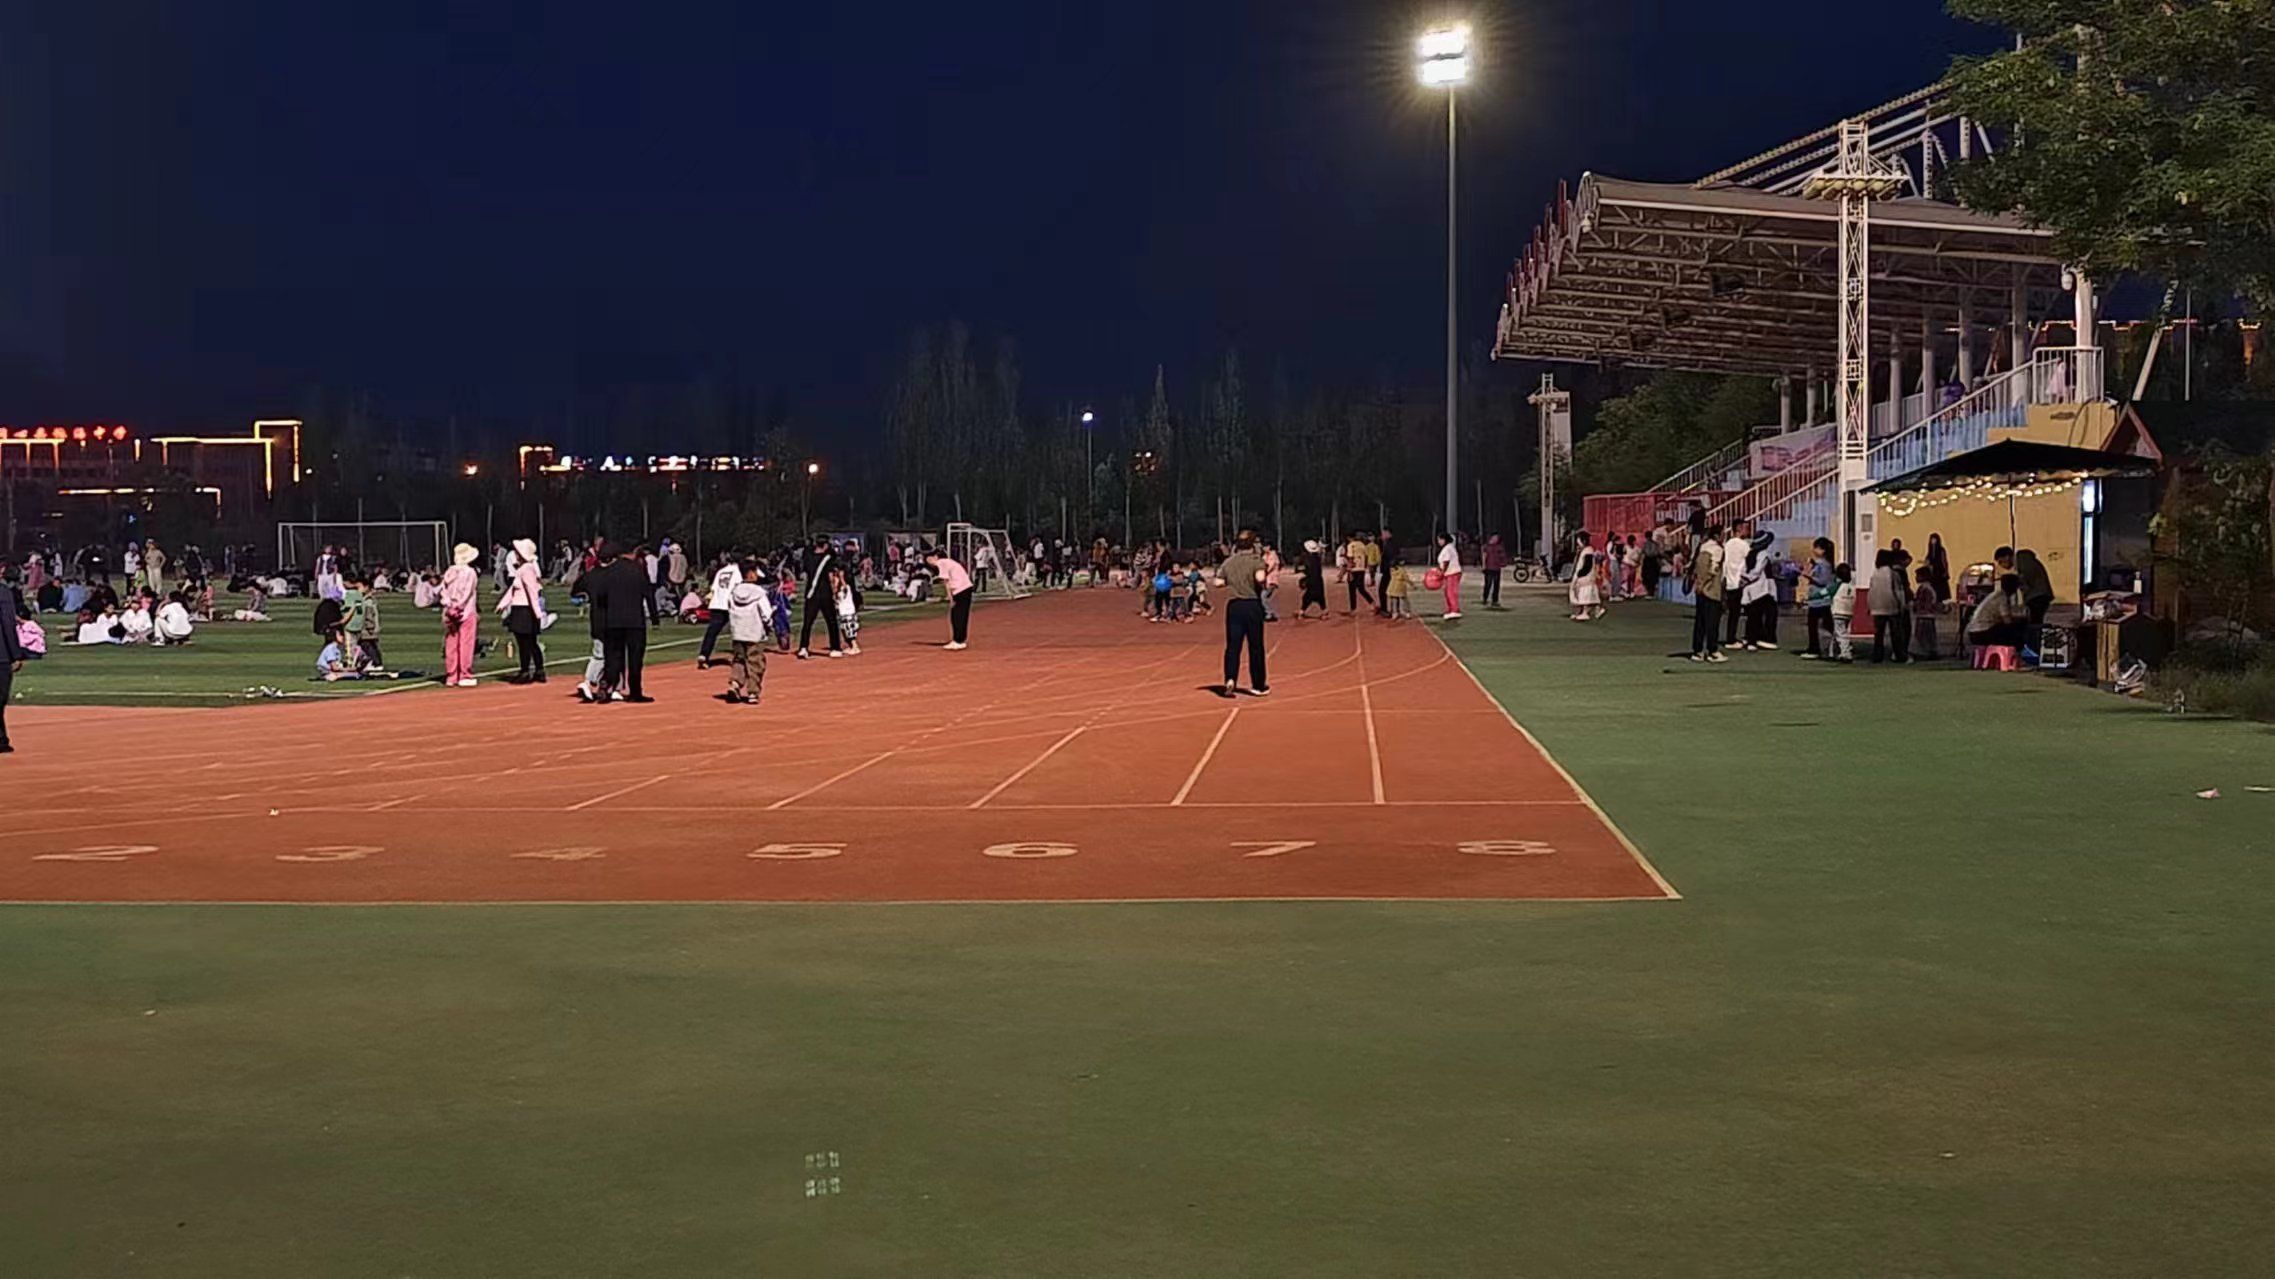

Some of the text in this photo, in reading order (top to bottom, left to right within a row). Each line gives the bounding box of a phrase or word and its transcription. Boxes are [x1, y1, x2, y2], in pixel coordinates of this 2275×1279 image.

[32, 844, 160, 861] 2
[275, 845, 385, 862] 3
[510, 846, 609, 861] 4
[746, 842, 849, 859] 5
[982, 841, 1079, 858] 6
[1229, 840, 1317, 857] 7
[1456, 840, 1557, 855] 8
